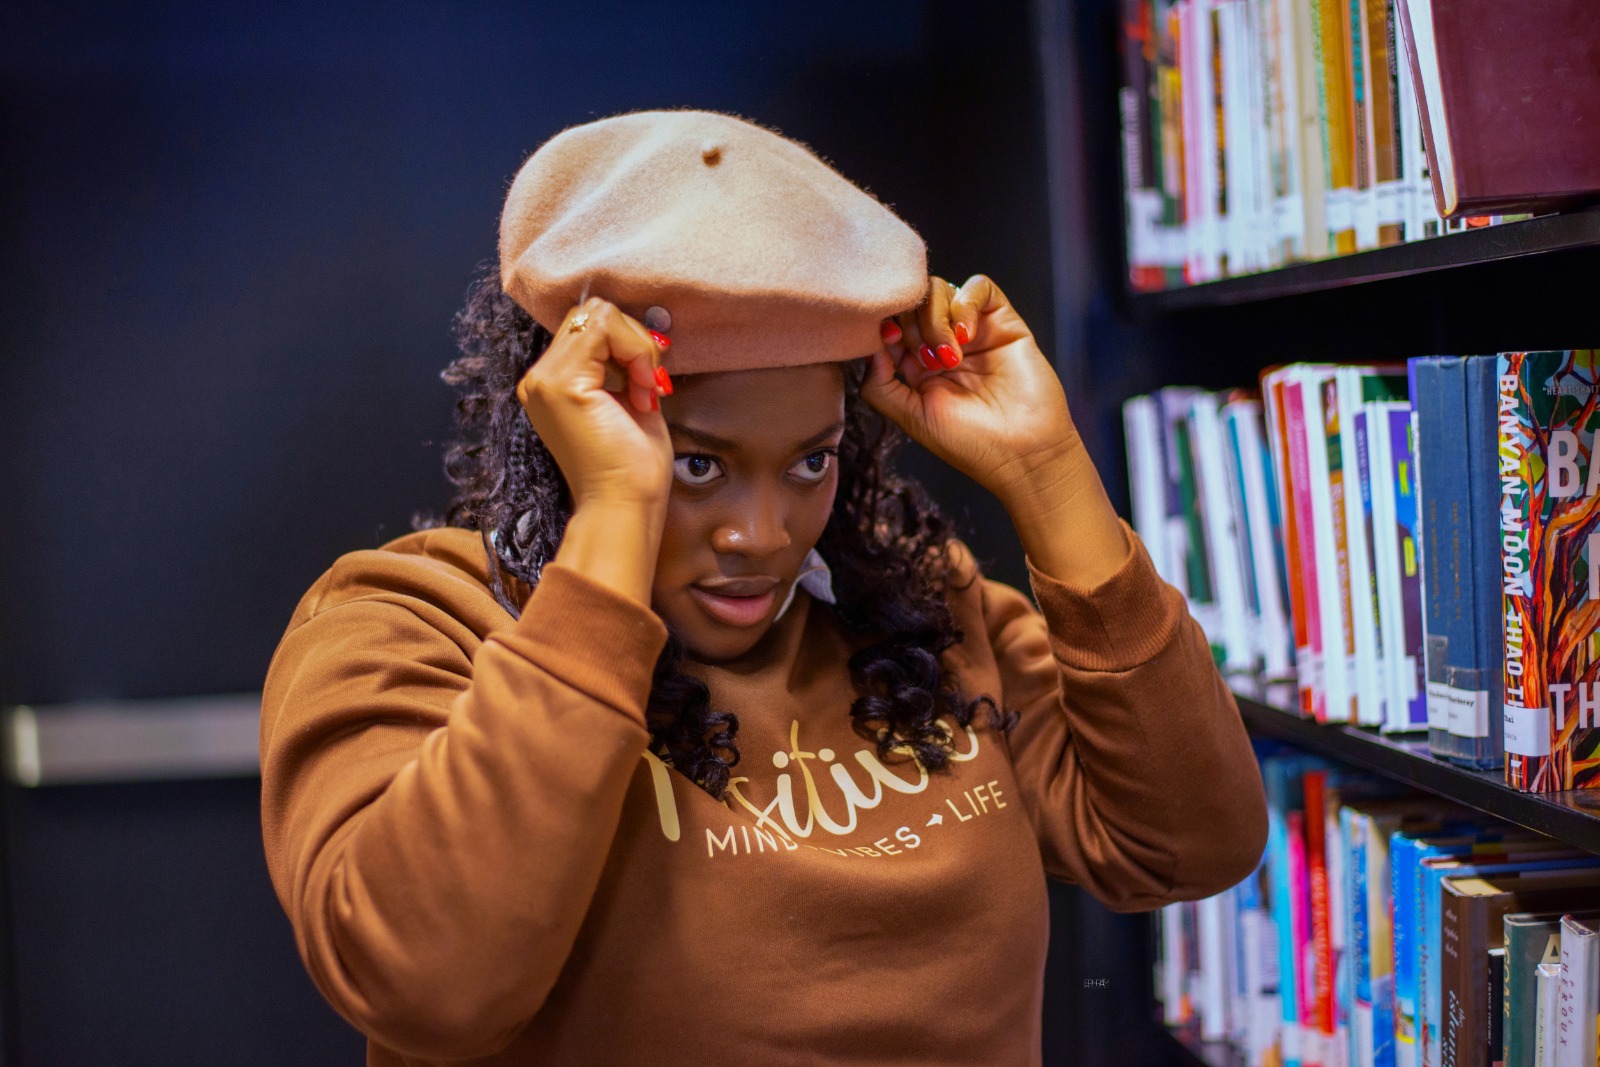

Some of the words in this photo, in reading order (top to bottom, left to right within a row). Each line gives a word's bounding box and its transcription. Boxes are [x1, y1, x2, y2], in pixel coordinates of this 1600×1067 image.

[1500, 374, 1521, 494] BANYAN
[1502, 508, 1523, 596] MOON
[1506, 612, 1523, 676] THAO
[946, 780, 1007, 822] LIFE
[1560, 950, 1569, 1047] THEROUX
